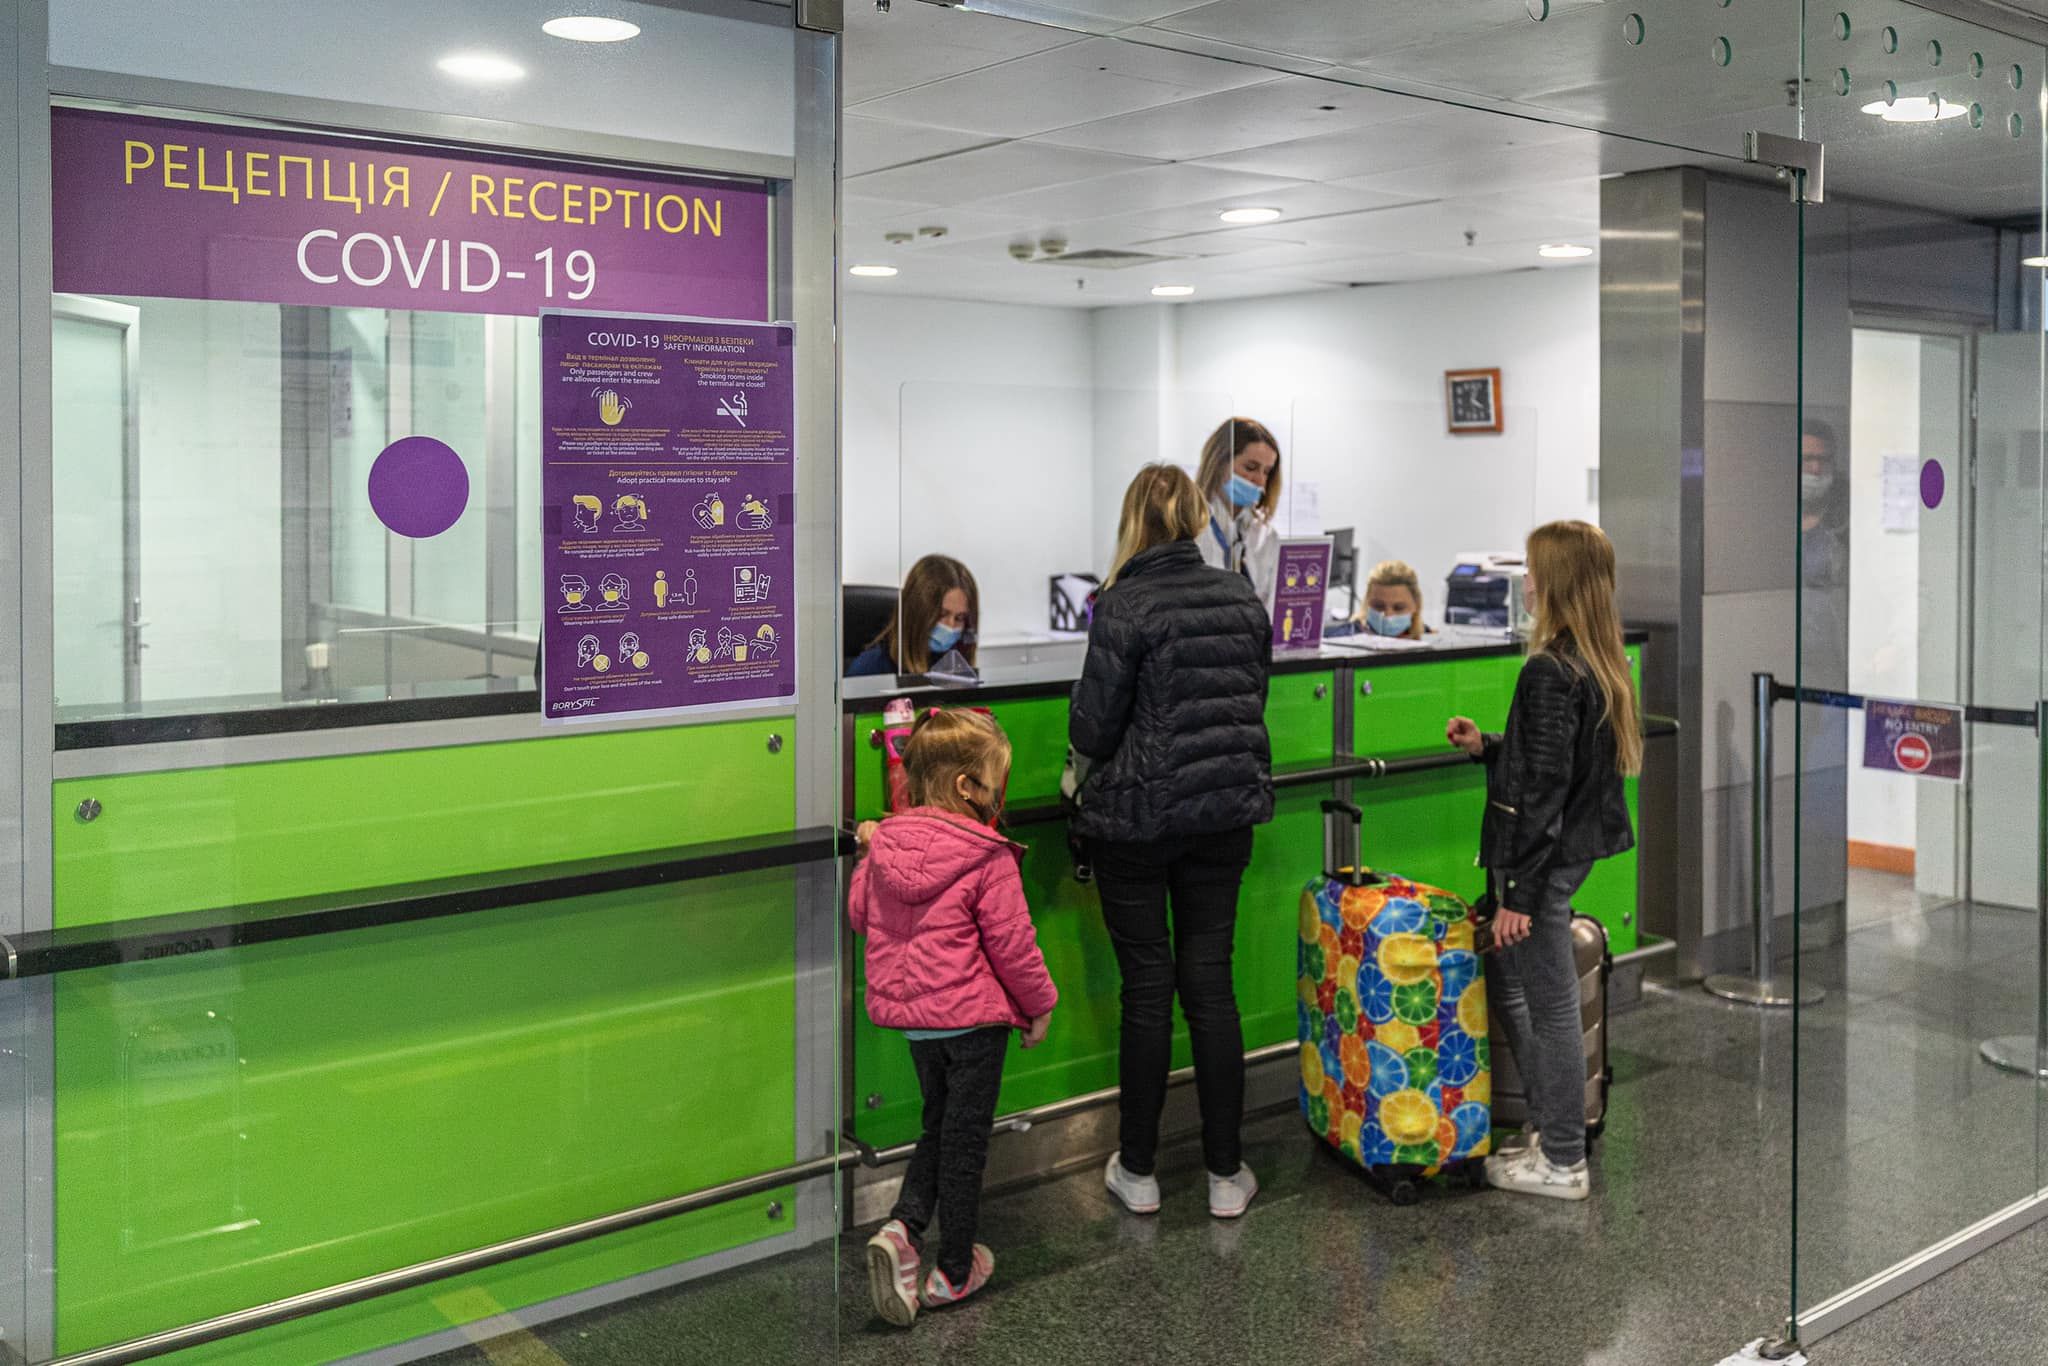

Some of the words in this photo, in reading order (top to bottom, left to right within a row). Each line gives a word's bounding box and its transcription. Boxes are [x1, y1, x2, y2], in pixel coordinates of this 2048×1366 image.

[124, 140, 411, 214] РЕЦЕПЦІЯ
[429, 171, 452, 216] /
[471, 174, 723, 237] RECEPTION
[296, 229, 597, 300] COVID-19
[588, 332, 660, 348] COVID-19
[664, 334, 712, 343] ІНФОРМАЦІЯ
[664, 342, 691, 351] SAFETY
[692, 344, 745, 353] INFORMATION
[700, 372, 726, 380] Smoking
[552, 698, 599, 711] BORYSPIL
[1884, 718, 1903, 731] NO
[1904, 719, 1940, 735] ENTRY
